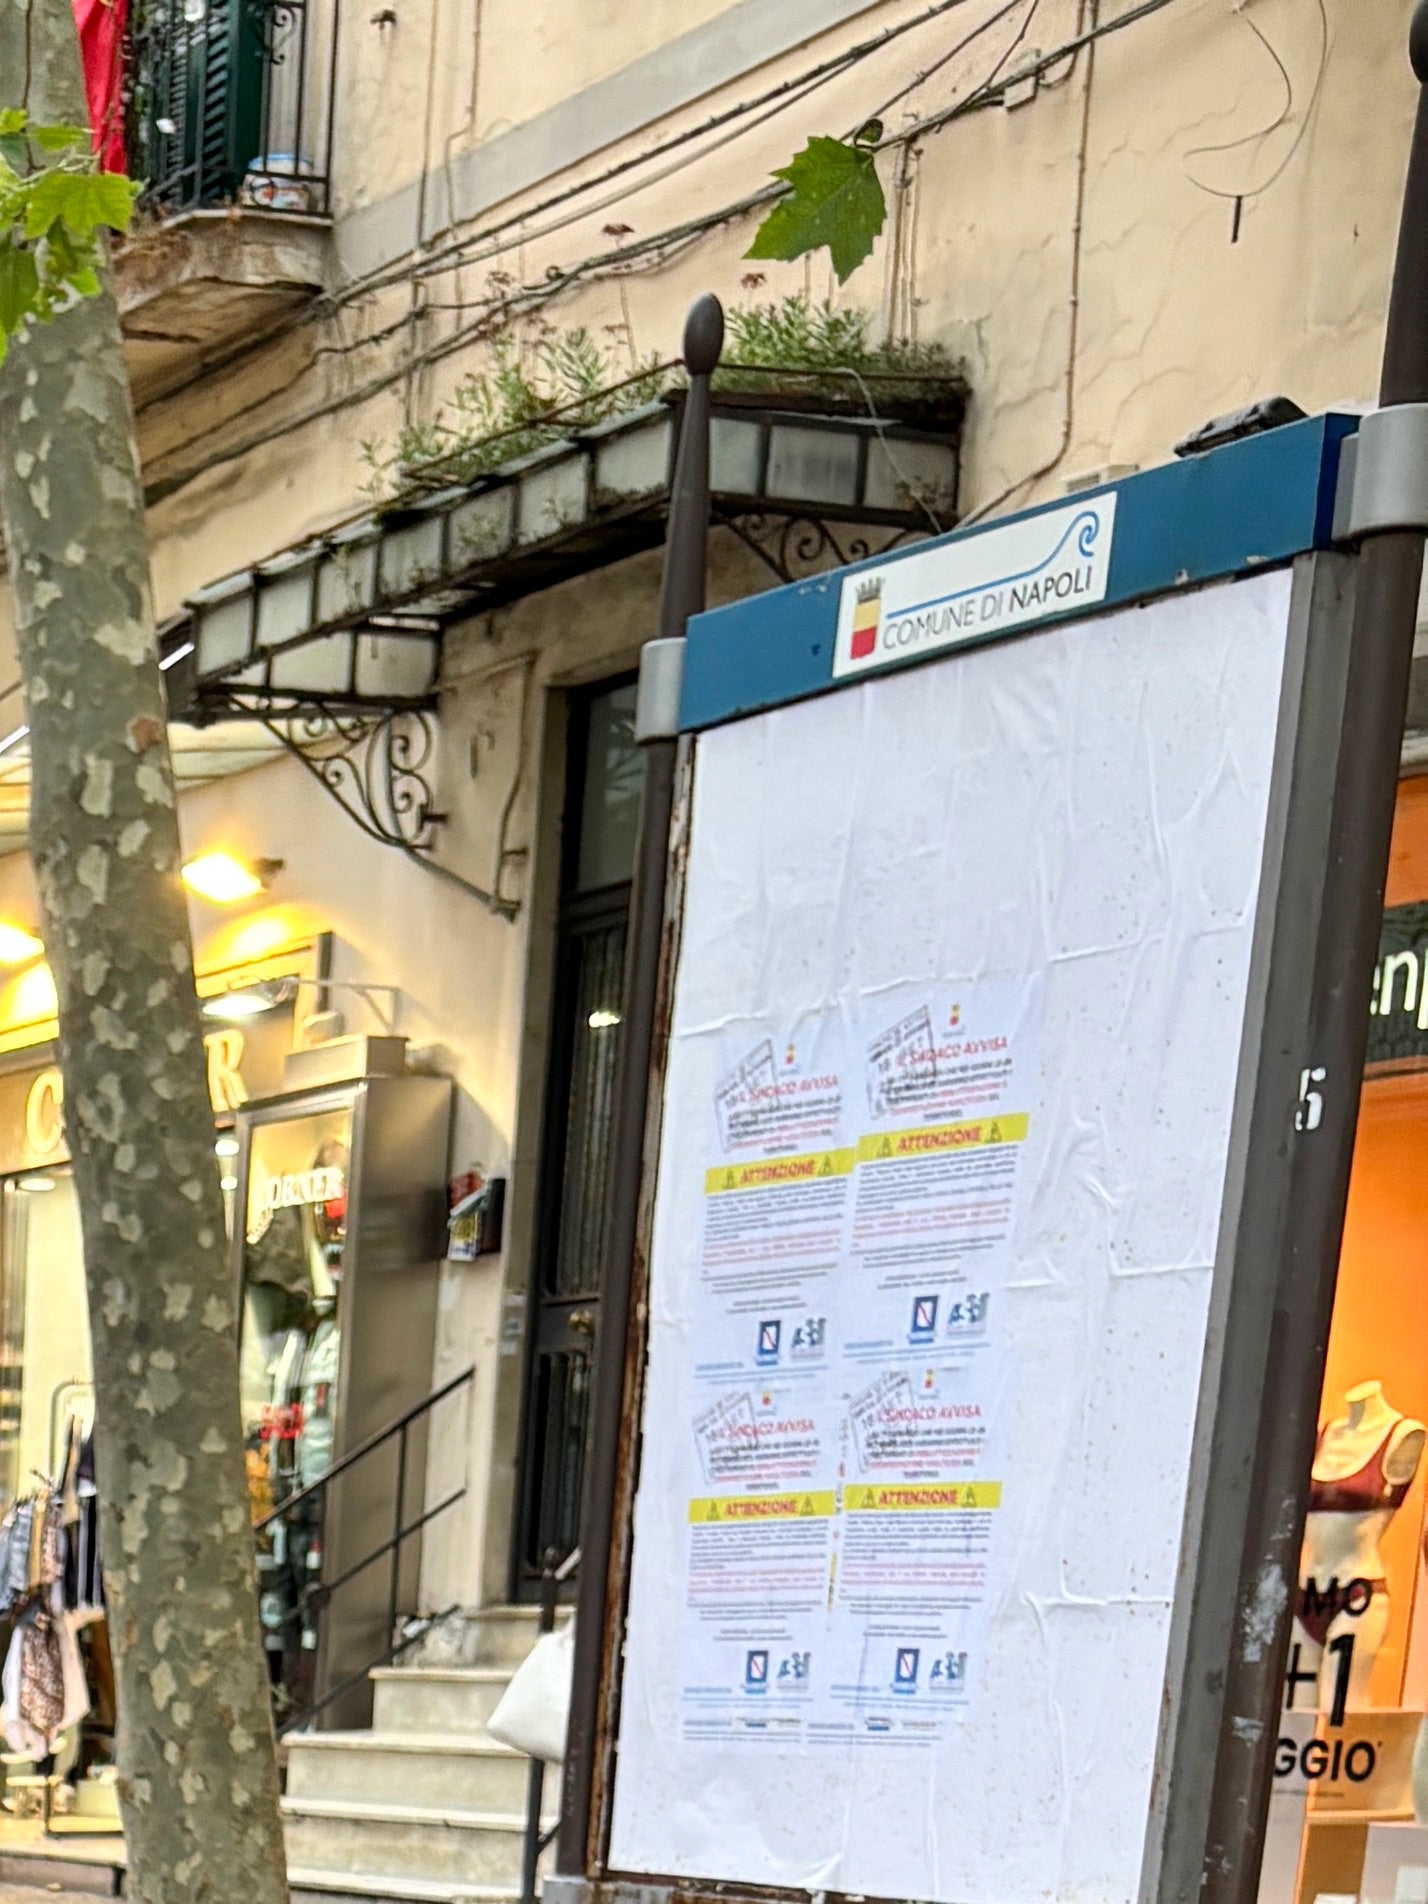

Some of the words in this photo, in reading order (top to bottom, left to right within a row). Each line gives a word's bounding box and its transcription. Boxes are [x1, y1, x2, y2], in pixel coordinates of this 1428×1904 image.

[882, 598, 975, 650] COMUNE
[980, 591, 1004, 622] DI
[1008, 565, 1093, 613] NAPOLI
[1294, 1066, 1327, 1132] 5
[897, 1125, 983, 1152] ATTENZIONE
[740, 1158, 817, 1185] ATTENZIONE
[725, 1498, 798, 1517] ATTENZIONE
[878, 1488, 959, 1506] ATTENZIONE
